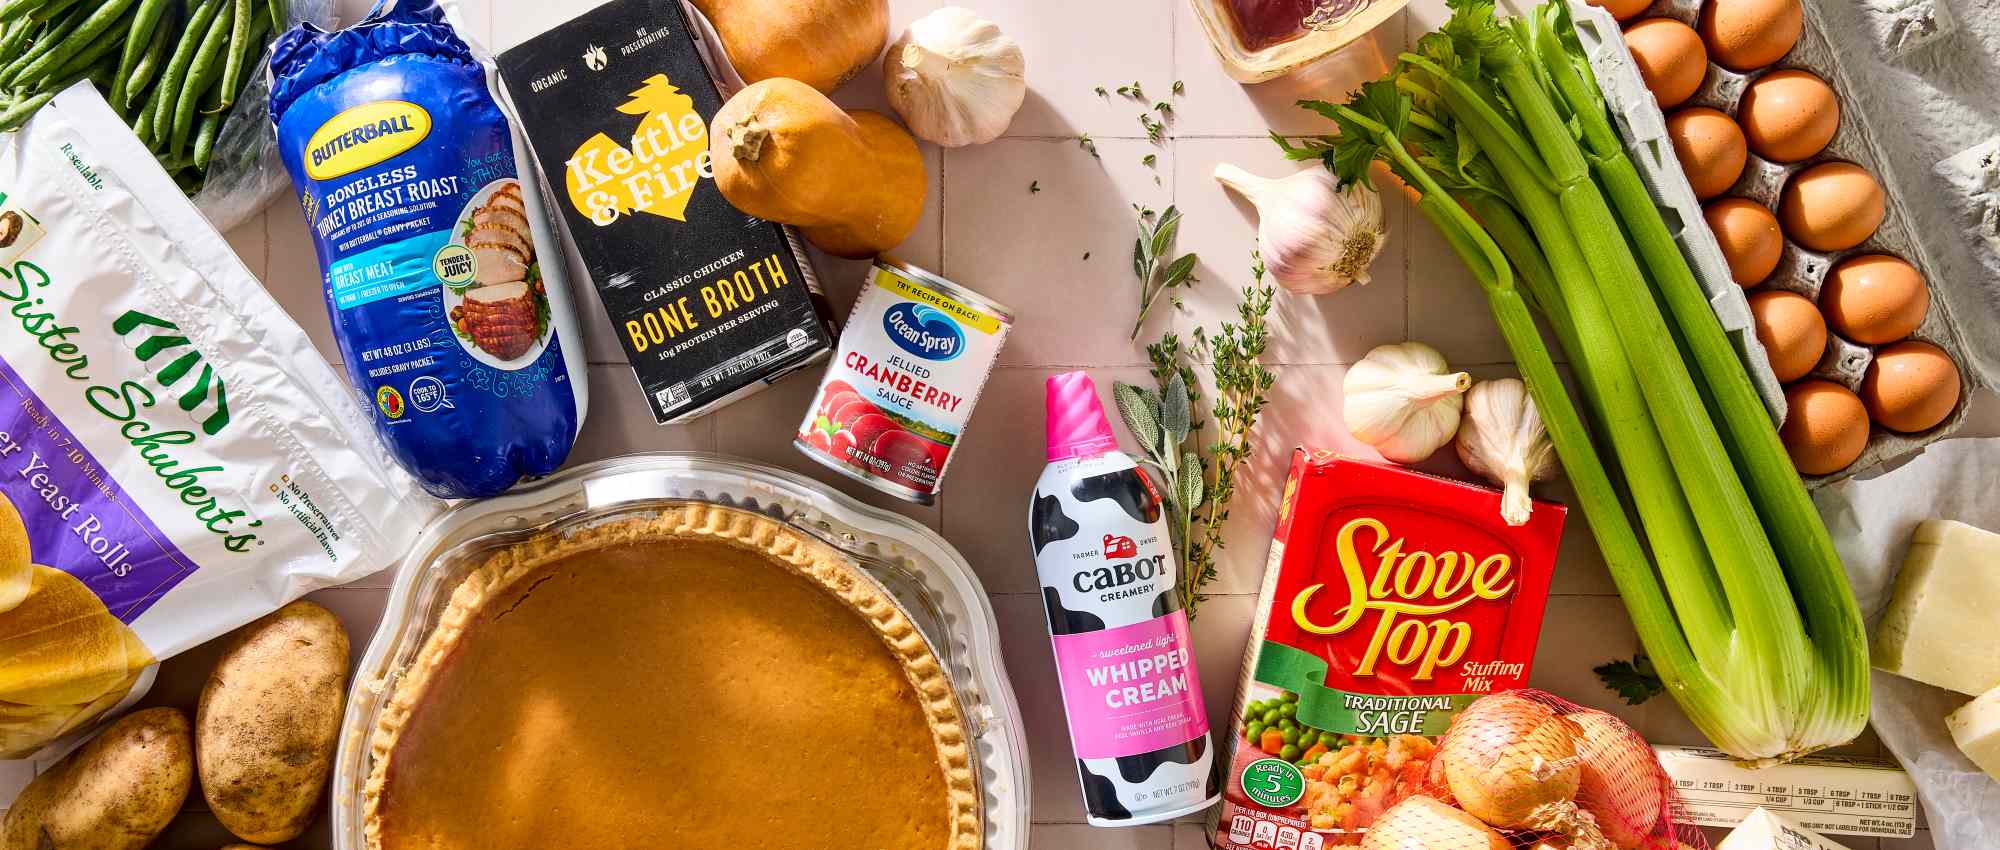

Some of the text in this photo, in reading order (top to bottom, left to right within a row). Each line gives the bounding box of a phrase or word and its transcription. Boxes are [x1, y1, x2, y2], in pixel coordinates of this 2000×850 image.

[621, 26, 670, 56] PRESERVATIVES
[637, 26, 648, 37] NO
[530, 69, 568, 93] ORGANIC
[311, 115, 414, 167] BUTTERBALL
[564, 111, 705, 194] Kettle
[60, 142, 103, 191] Resealable
[326, 165, 417, 207] BONELESS
[585, 150, 713, 227] & Fire
[317, 202, 347, 239] TURKEY
[348, 184, 402, 220] BREAST
[409, 175, 459, 202] ROAST
[383, 223, 404, 236] GRAVY
[404, 217, 431, 230] PACKET
[335, 270, 365, 290] BREAST
[366, 260, 394, 280] MEAT
[440, 254, 471, 267] TENDER &
[443, 264, 473, 279] JUICY
[643, 249, 745, 302] CLASSIC CHICKEN
[626, 254, 789, 353] BONE BROTH
[896, 280, 980, 322] TRY RECIPE ON BACK!
[0, 260, 90, 380] Sister
[658, 299, 780, 361] 10g PROTEIN PER SERVING
[889, 310, 956, 354] Ocean Spray
[362, 337, 432, 362] NET WT 48 OZ (3 LBS)
[410, 356, 435, 370] PACKET
[886, 353, 931, 379] JELLIED
[427, 385, 437, 393] TO
[845, 351, 962, 413] CRANBERRY
[876, 387, 914, 410] SAUCE
[22, 398, 118, 502] Ready in 7-10 Minutes
[85, 381, 257, 553] Schubert's
[18, 451, 81, 521] Yeast
[72, 512, 133, 578] Rolls
[276, 490, 338, 563] No Artificial Flavors
[287, 481, 342, 542] No Preservatives
[1072, 549, 1099, 559] FARMER
[1291, 517, 1515, 635] Stove
[1100, 583, 1155, 602] CREAMERY
[1099, 641, 1153, 658] sweetened
[1345, 604, 1472, 681] Top
[1085, 647, 1189, 687] WHIPPED
[1460, 660, 1524, 680] Stuffing
[1105, 673, 1189, 708] CREAM
[1462, 677, 1493, 693] Mix
[1344, 694, 1452, 711] TRADITIONAL
[1356, 710, 1426, 734] SAGE
[1255, 763, 1295, 782] Ready in
[1265, 774, 1282, 793] 5
[1252, 786, 1291, 803] minutes
[1235, 818, 1251, 831] 110
